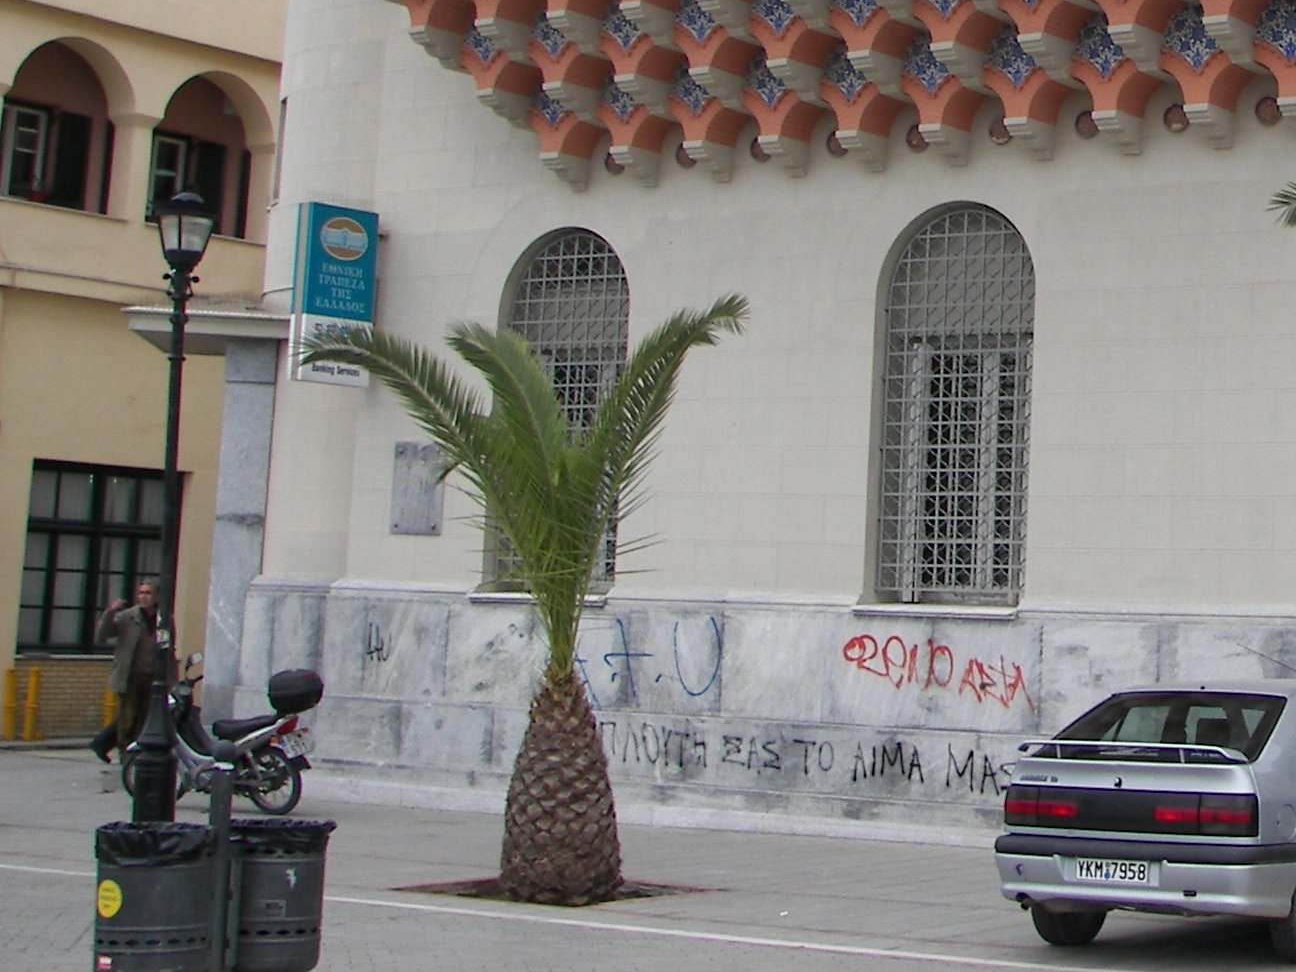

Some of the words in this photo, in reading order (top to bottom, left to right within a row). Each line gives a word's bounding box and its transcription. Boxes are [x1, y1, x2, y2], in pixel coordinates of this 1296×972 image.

[321, 262, 363, 278] ΕΘΝΙΚΗ
[318, 273, 366, 290] ΤΡΑΠΕΖΑ
[331, 287, 352, 300] ΤΗΣ
[315, 296, 366, 313] ΕΛΛΑΔΟΣ
[312, 362, 335, 375] Banking
[793, 738, 834, 775] ΤΟ
[852, 741, 925, 784] ΑΙΜΑ
[1111, 862, 1147, 881] 7958
